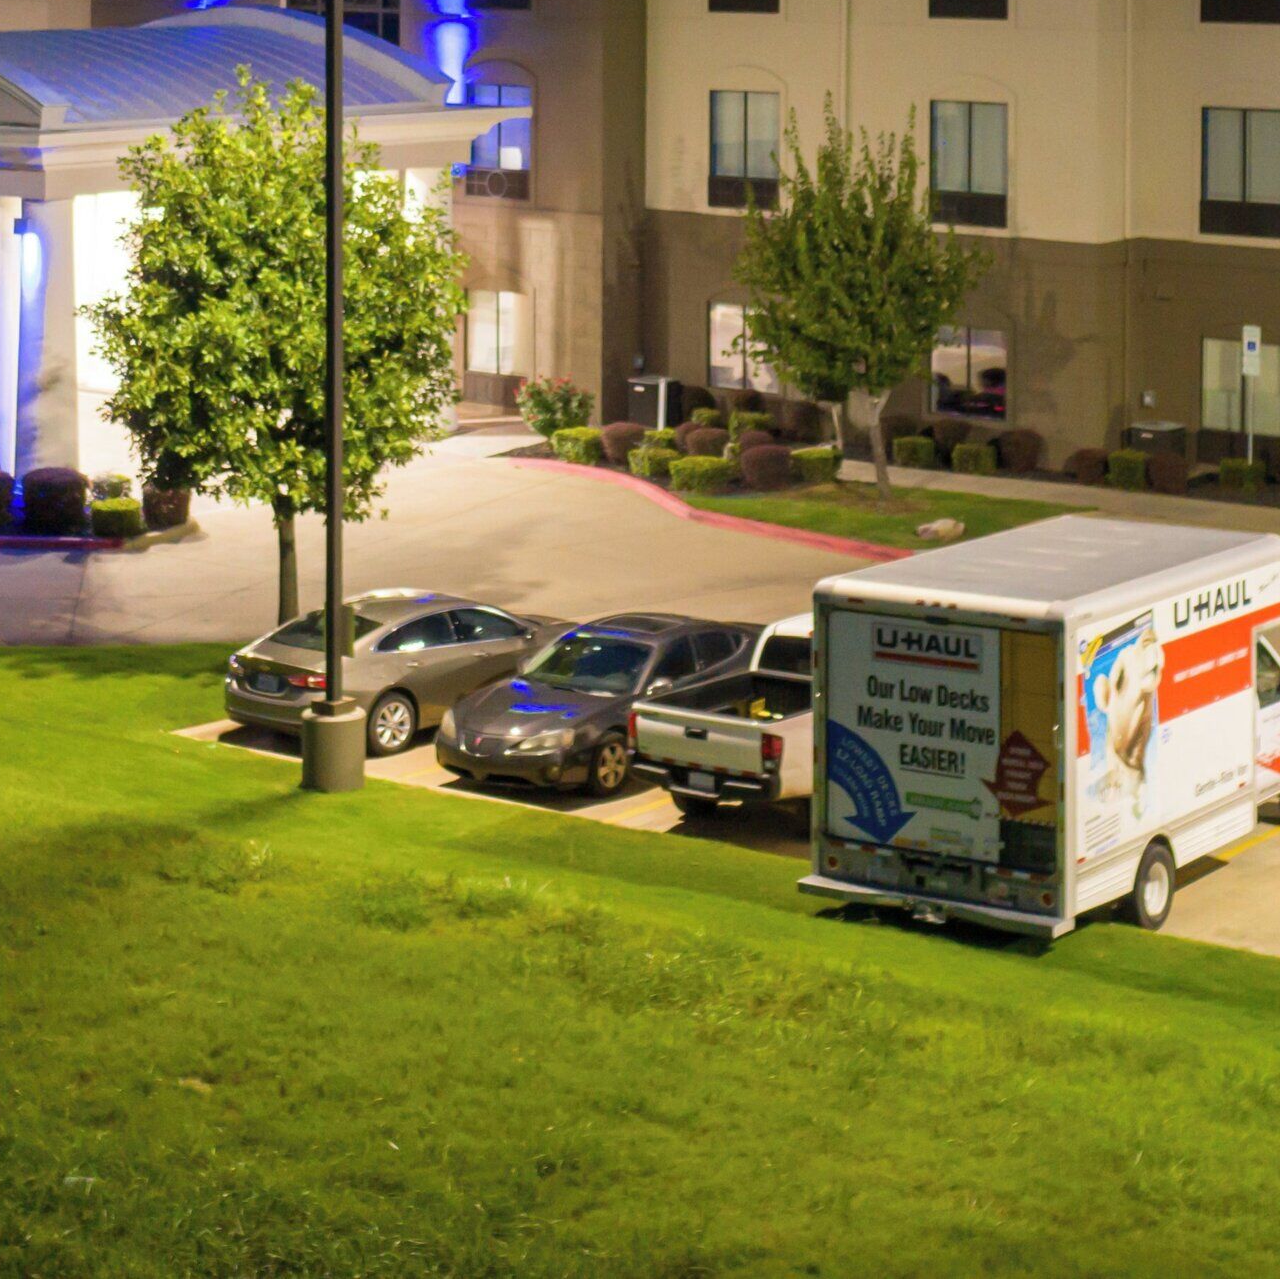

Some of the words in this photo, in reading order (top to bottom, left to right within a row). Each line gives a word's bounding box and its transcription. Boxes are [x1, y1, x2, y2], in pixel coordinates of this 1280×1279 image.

[867, 675, 895, 699] Our
[899, 679, 933, 704] Low
[937, 684, 990, 713] Decks
[857, 705, 902, 732] Make
[909, 710, 944, 737] Your
[950, 717, 995, 745] Move
[899, 744, 965, 774] EASIER!
